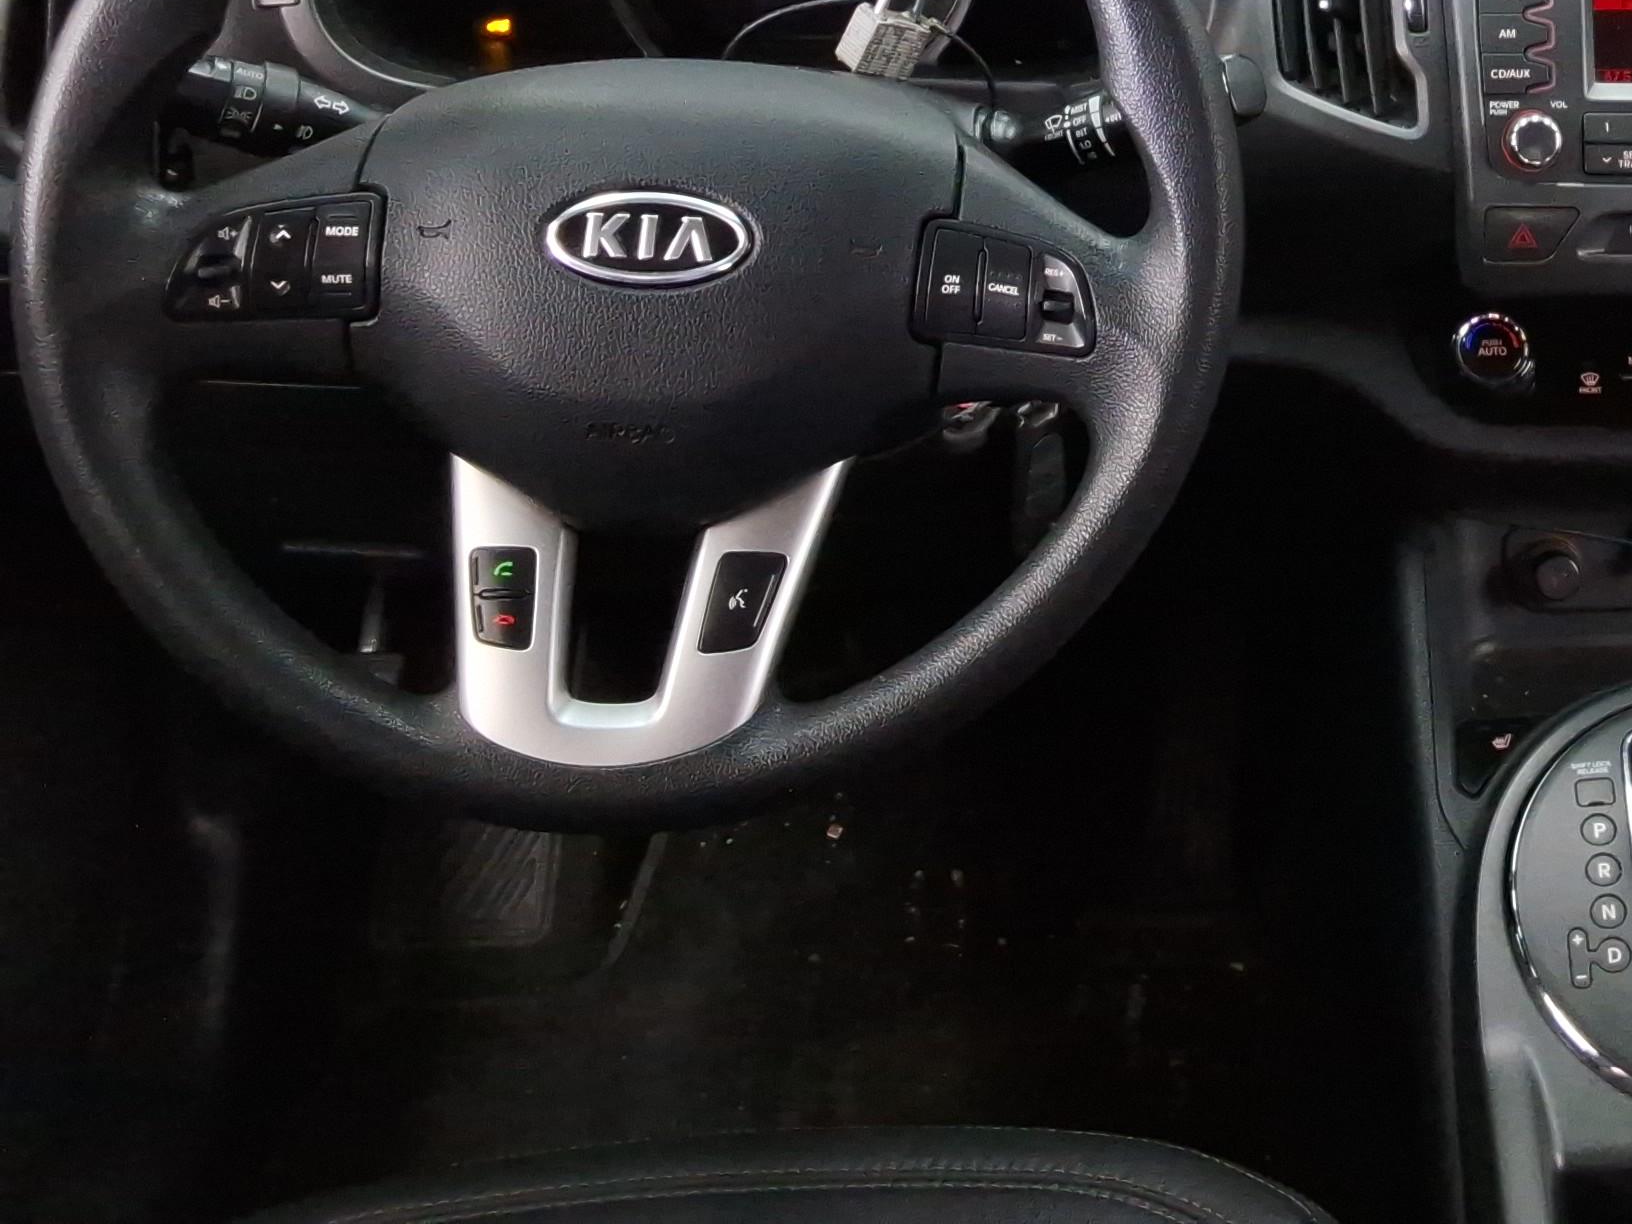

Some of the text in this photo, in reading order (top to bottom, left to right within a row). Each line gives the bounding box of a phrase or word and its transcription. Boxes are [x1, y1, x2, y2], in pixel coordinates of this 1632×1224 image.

[1499, 29, 1516, 38] AM
[236, 67, 265, 80] AUTO
[1490, 68, 1530, 78] CD/AUX
[1489, 101, 1519, 109] POWER
[1550, 101, 1568, 109] VOL
[1072, 115, 1087, 126] OFF
[325, 226, 359, 237] MODE
[583, 212, 713, 262] KIA
[321, 274, 352, 284] MUTE
[944, 275, 960, 284] ON
[941, 285, 961, 294] OFF
[988, 283, 1019, 296] CANCEL
[1478, 346, 1507, 356] AUTO
[1577, 767, 1609, 775] RELEASE
[1593, 823, 1606, 838] P
[1598, 863, 1610, 878] R
[1602, 905, 1616, 920] N
[1608, 948, 1621, 963] D
